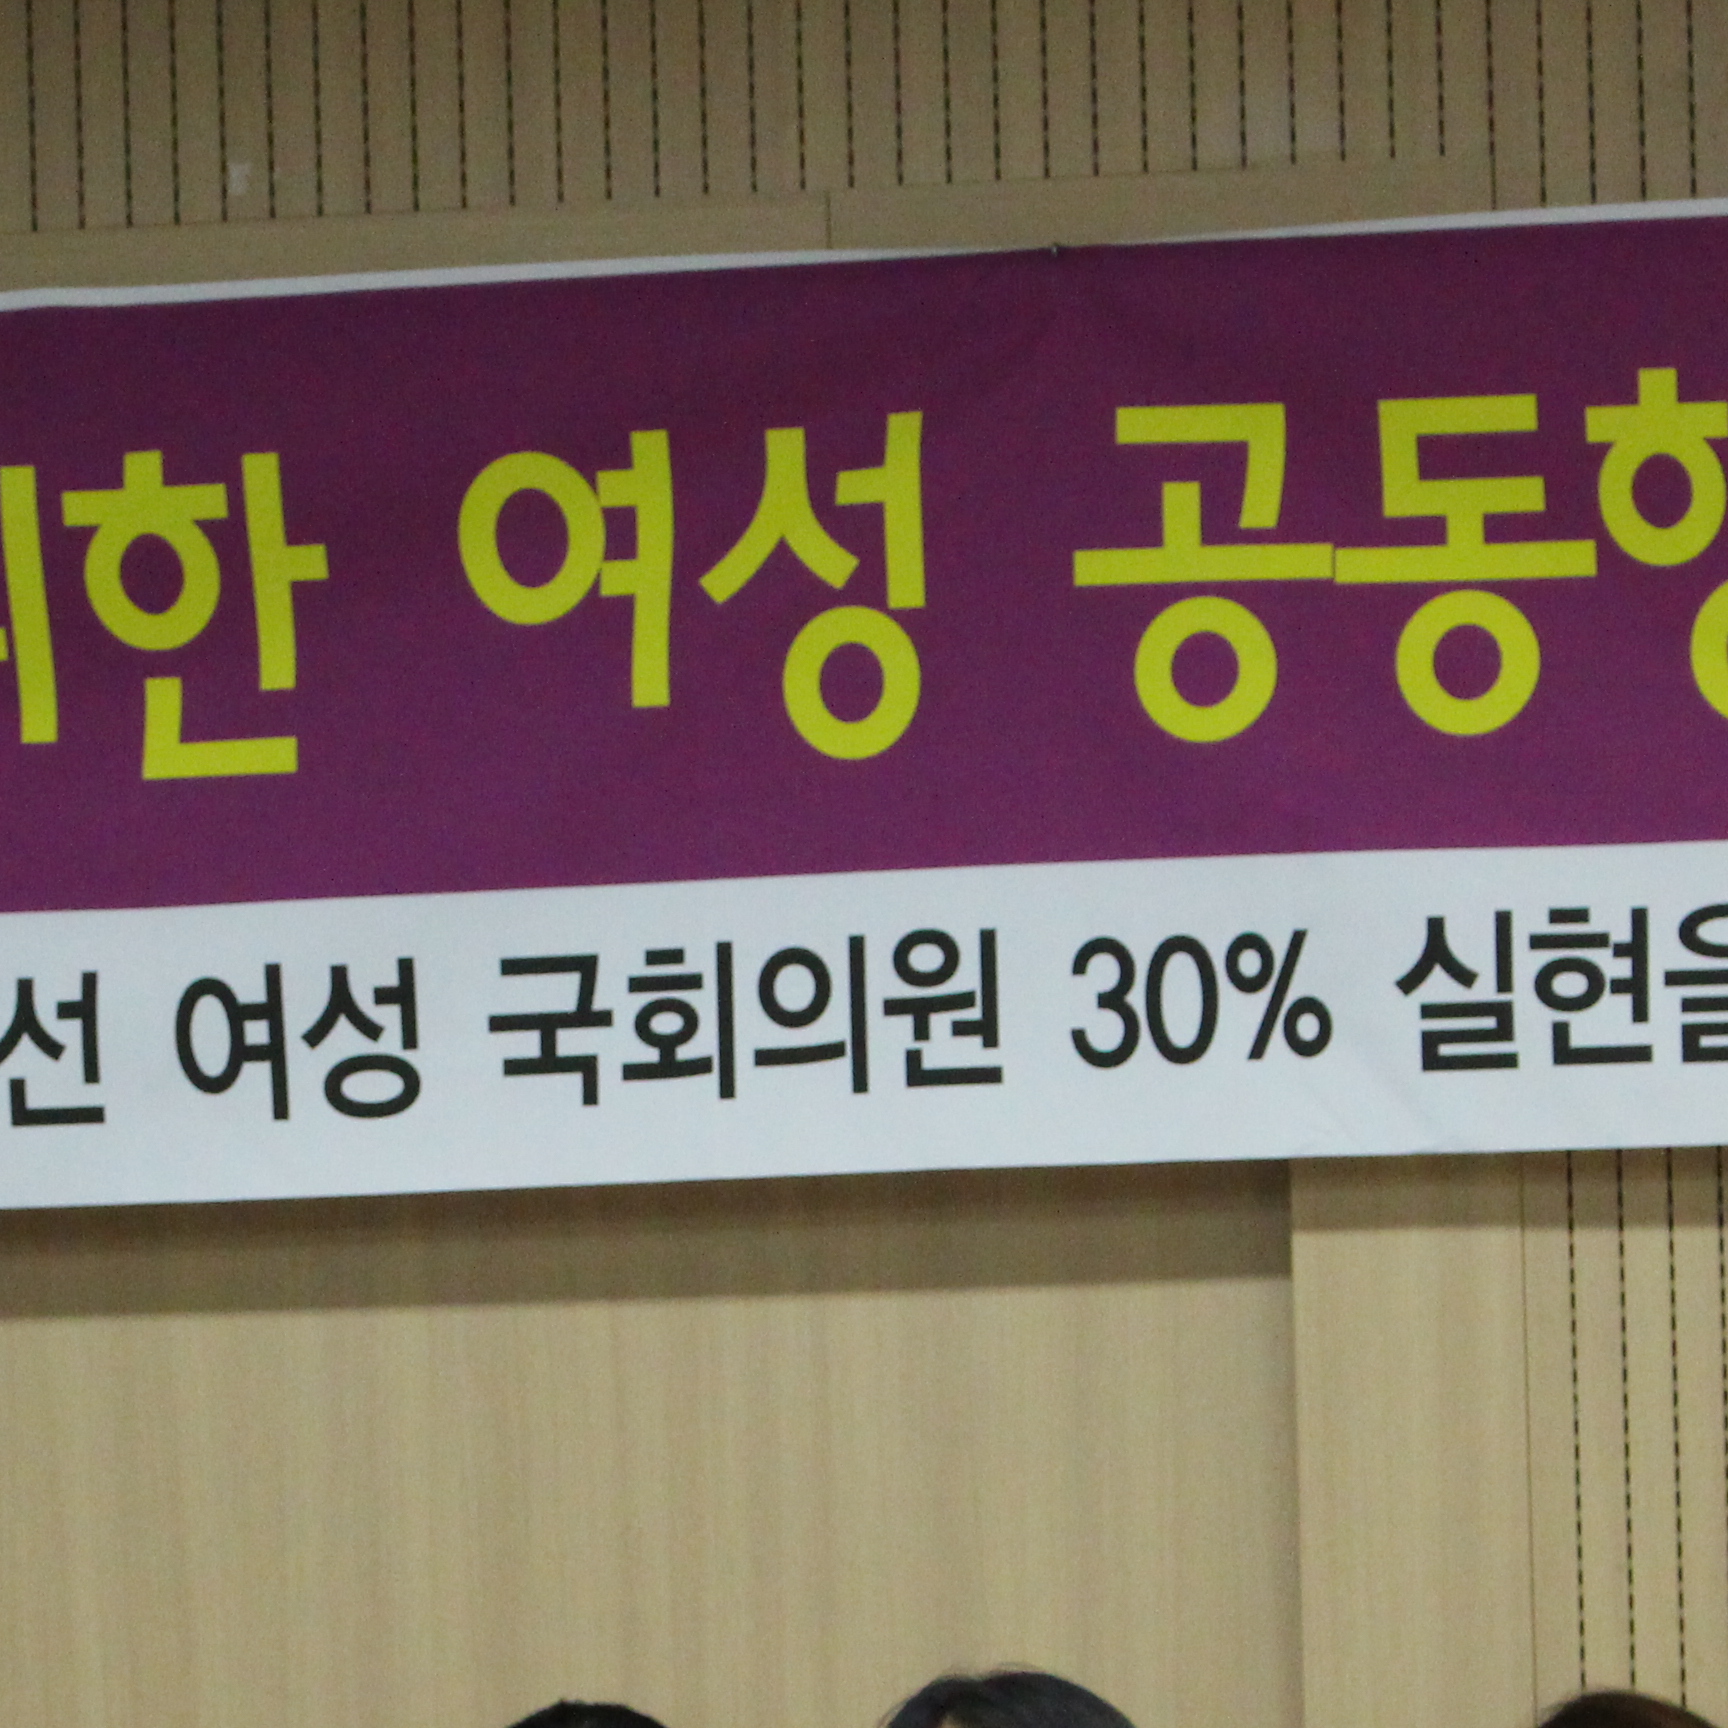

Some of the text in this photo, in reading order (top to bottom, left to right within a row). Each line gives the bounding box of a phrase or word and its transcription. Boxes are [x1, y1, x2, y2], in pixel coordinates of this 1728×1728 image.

[460, 412, 924, 758] 여성
[175, 958, 420, 1120] 여성
[488, 929, 1002, 1106] 국회의원
[1071, 929, 1332, 1068] 30%
